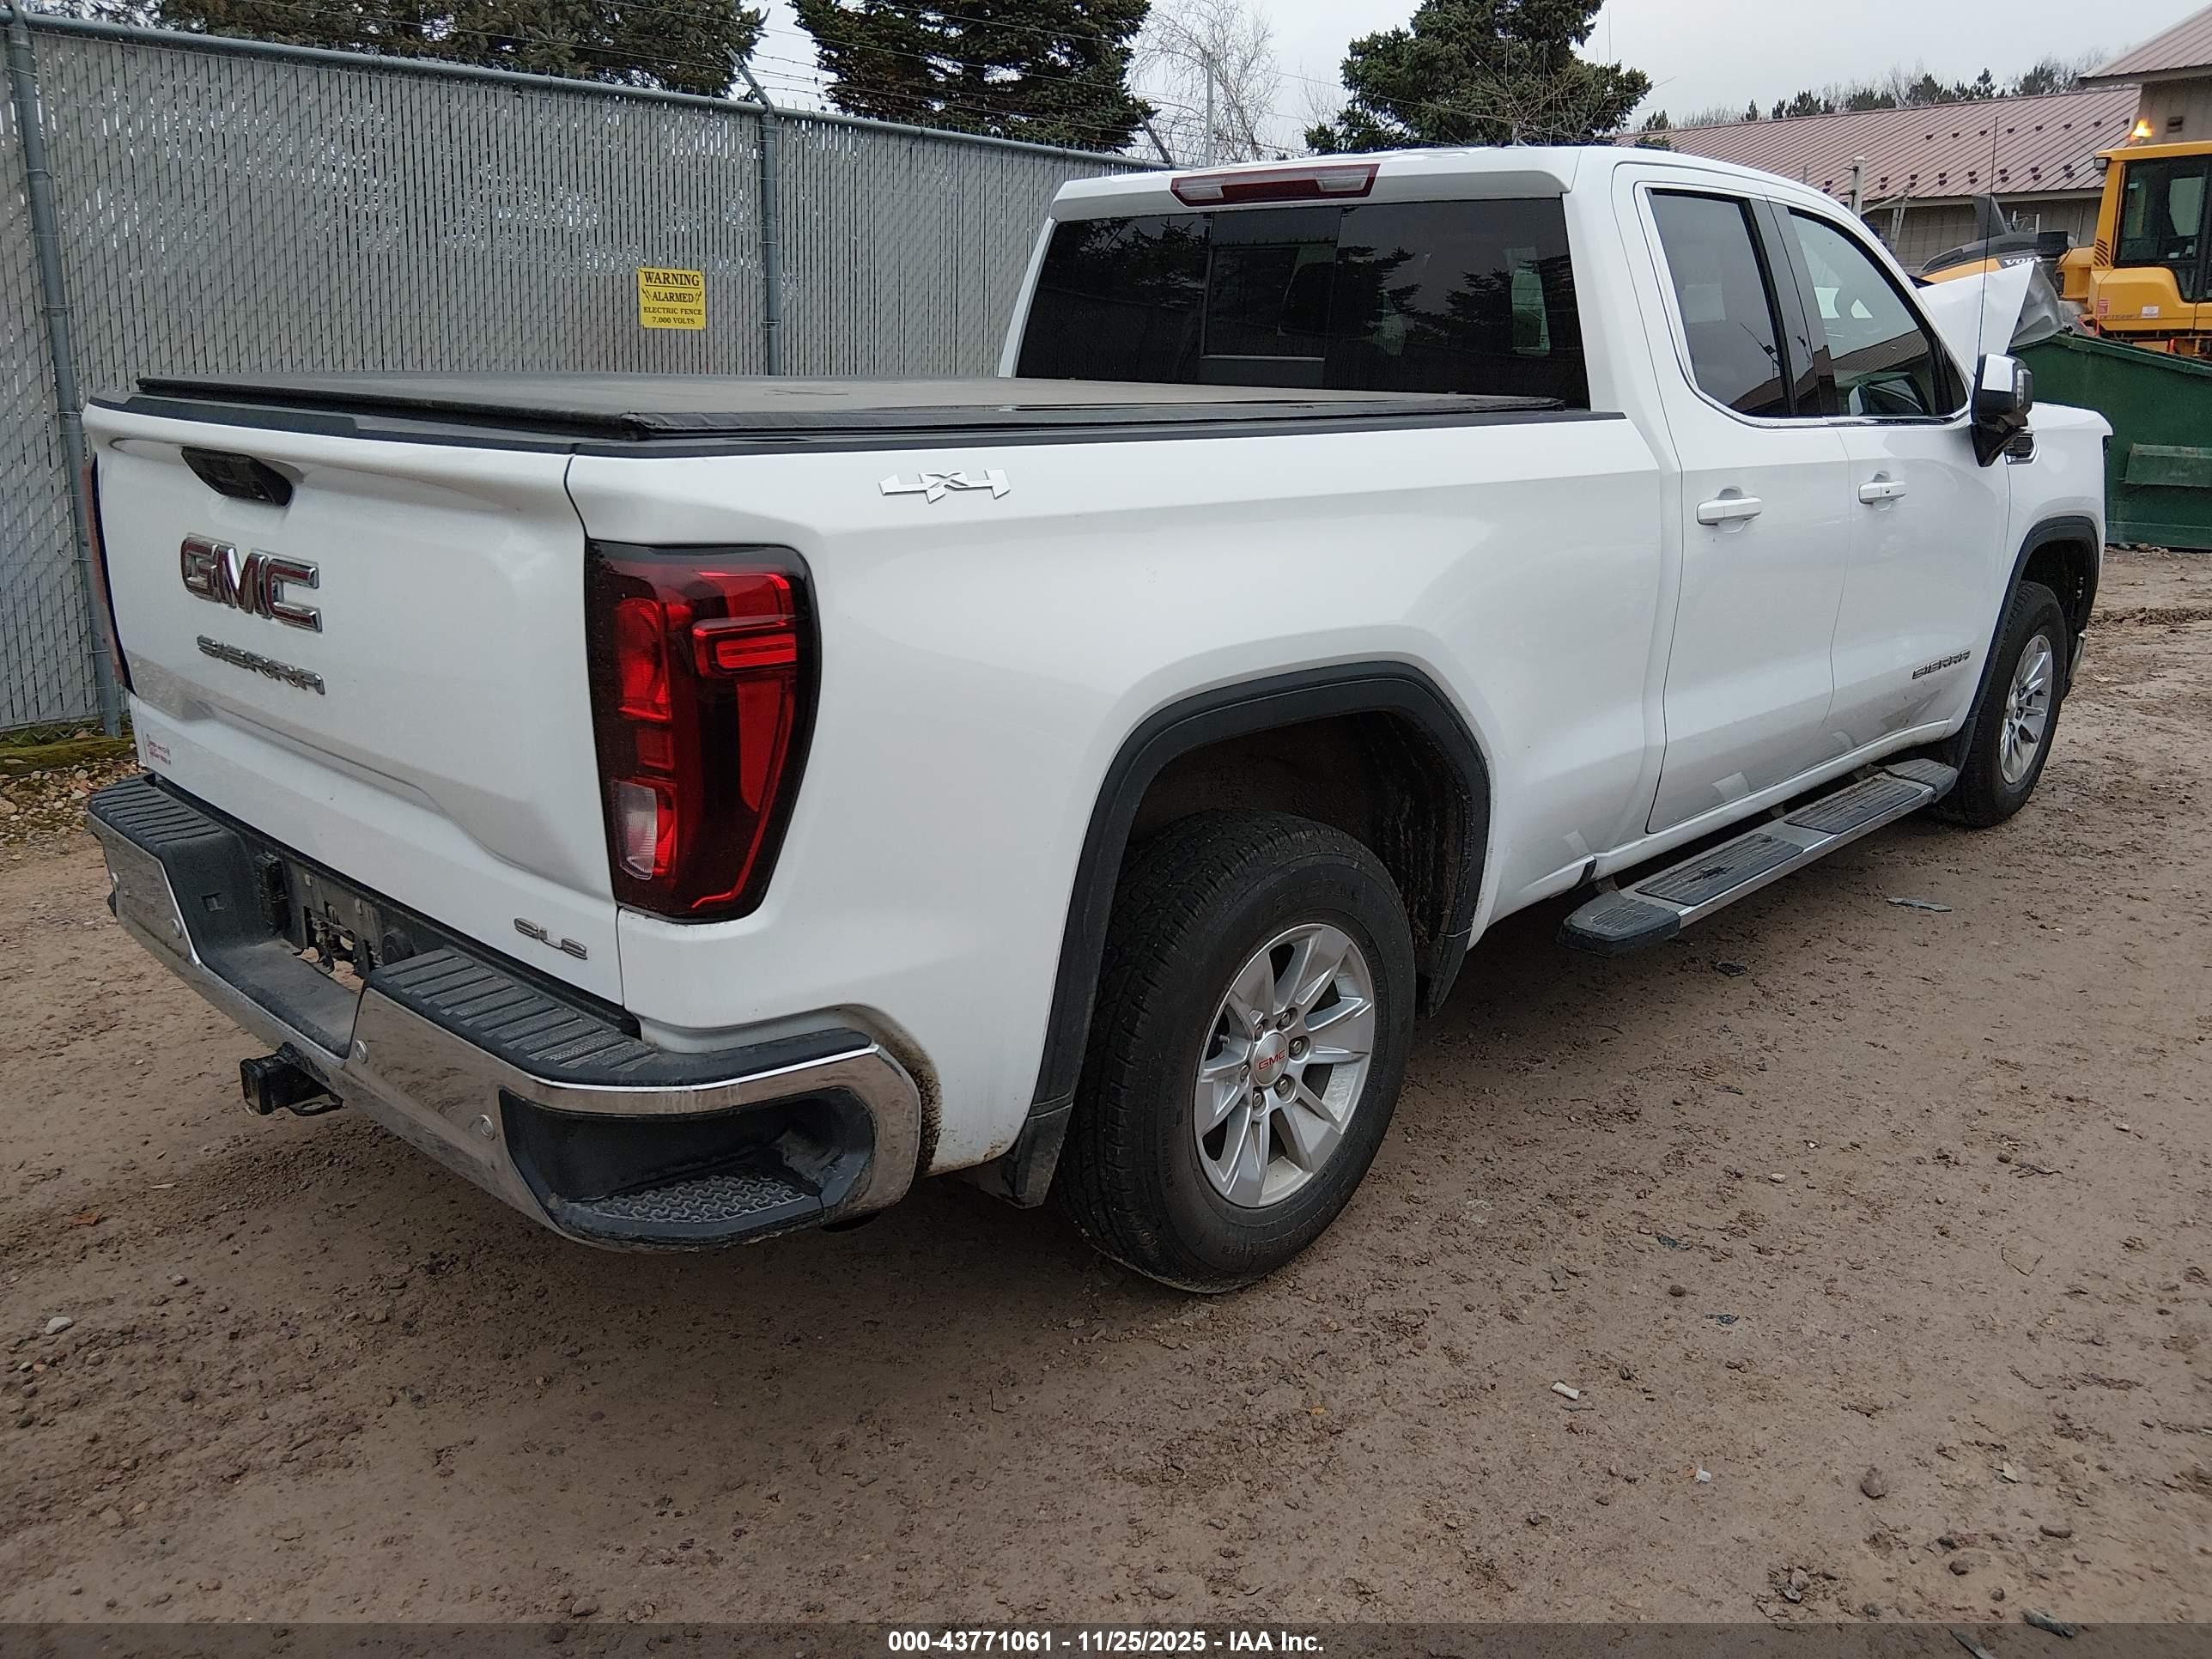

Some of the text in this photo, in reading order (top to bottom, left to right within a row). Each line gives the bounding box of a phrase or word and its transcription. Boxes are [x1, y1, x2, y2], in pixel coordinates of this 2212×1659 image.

[643, 271, 700, 286] WARNING
[652, 292, 694, 303] ALARMED
[179, 533, 323, 633] GMC
[197, 635, 325, 696] SIERRA
[1911, 649, 1971, 680] SIERRA
[514, 917, 588, 960] SLE
[1258, 1049, 1285, 1070] GMC
